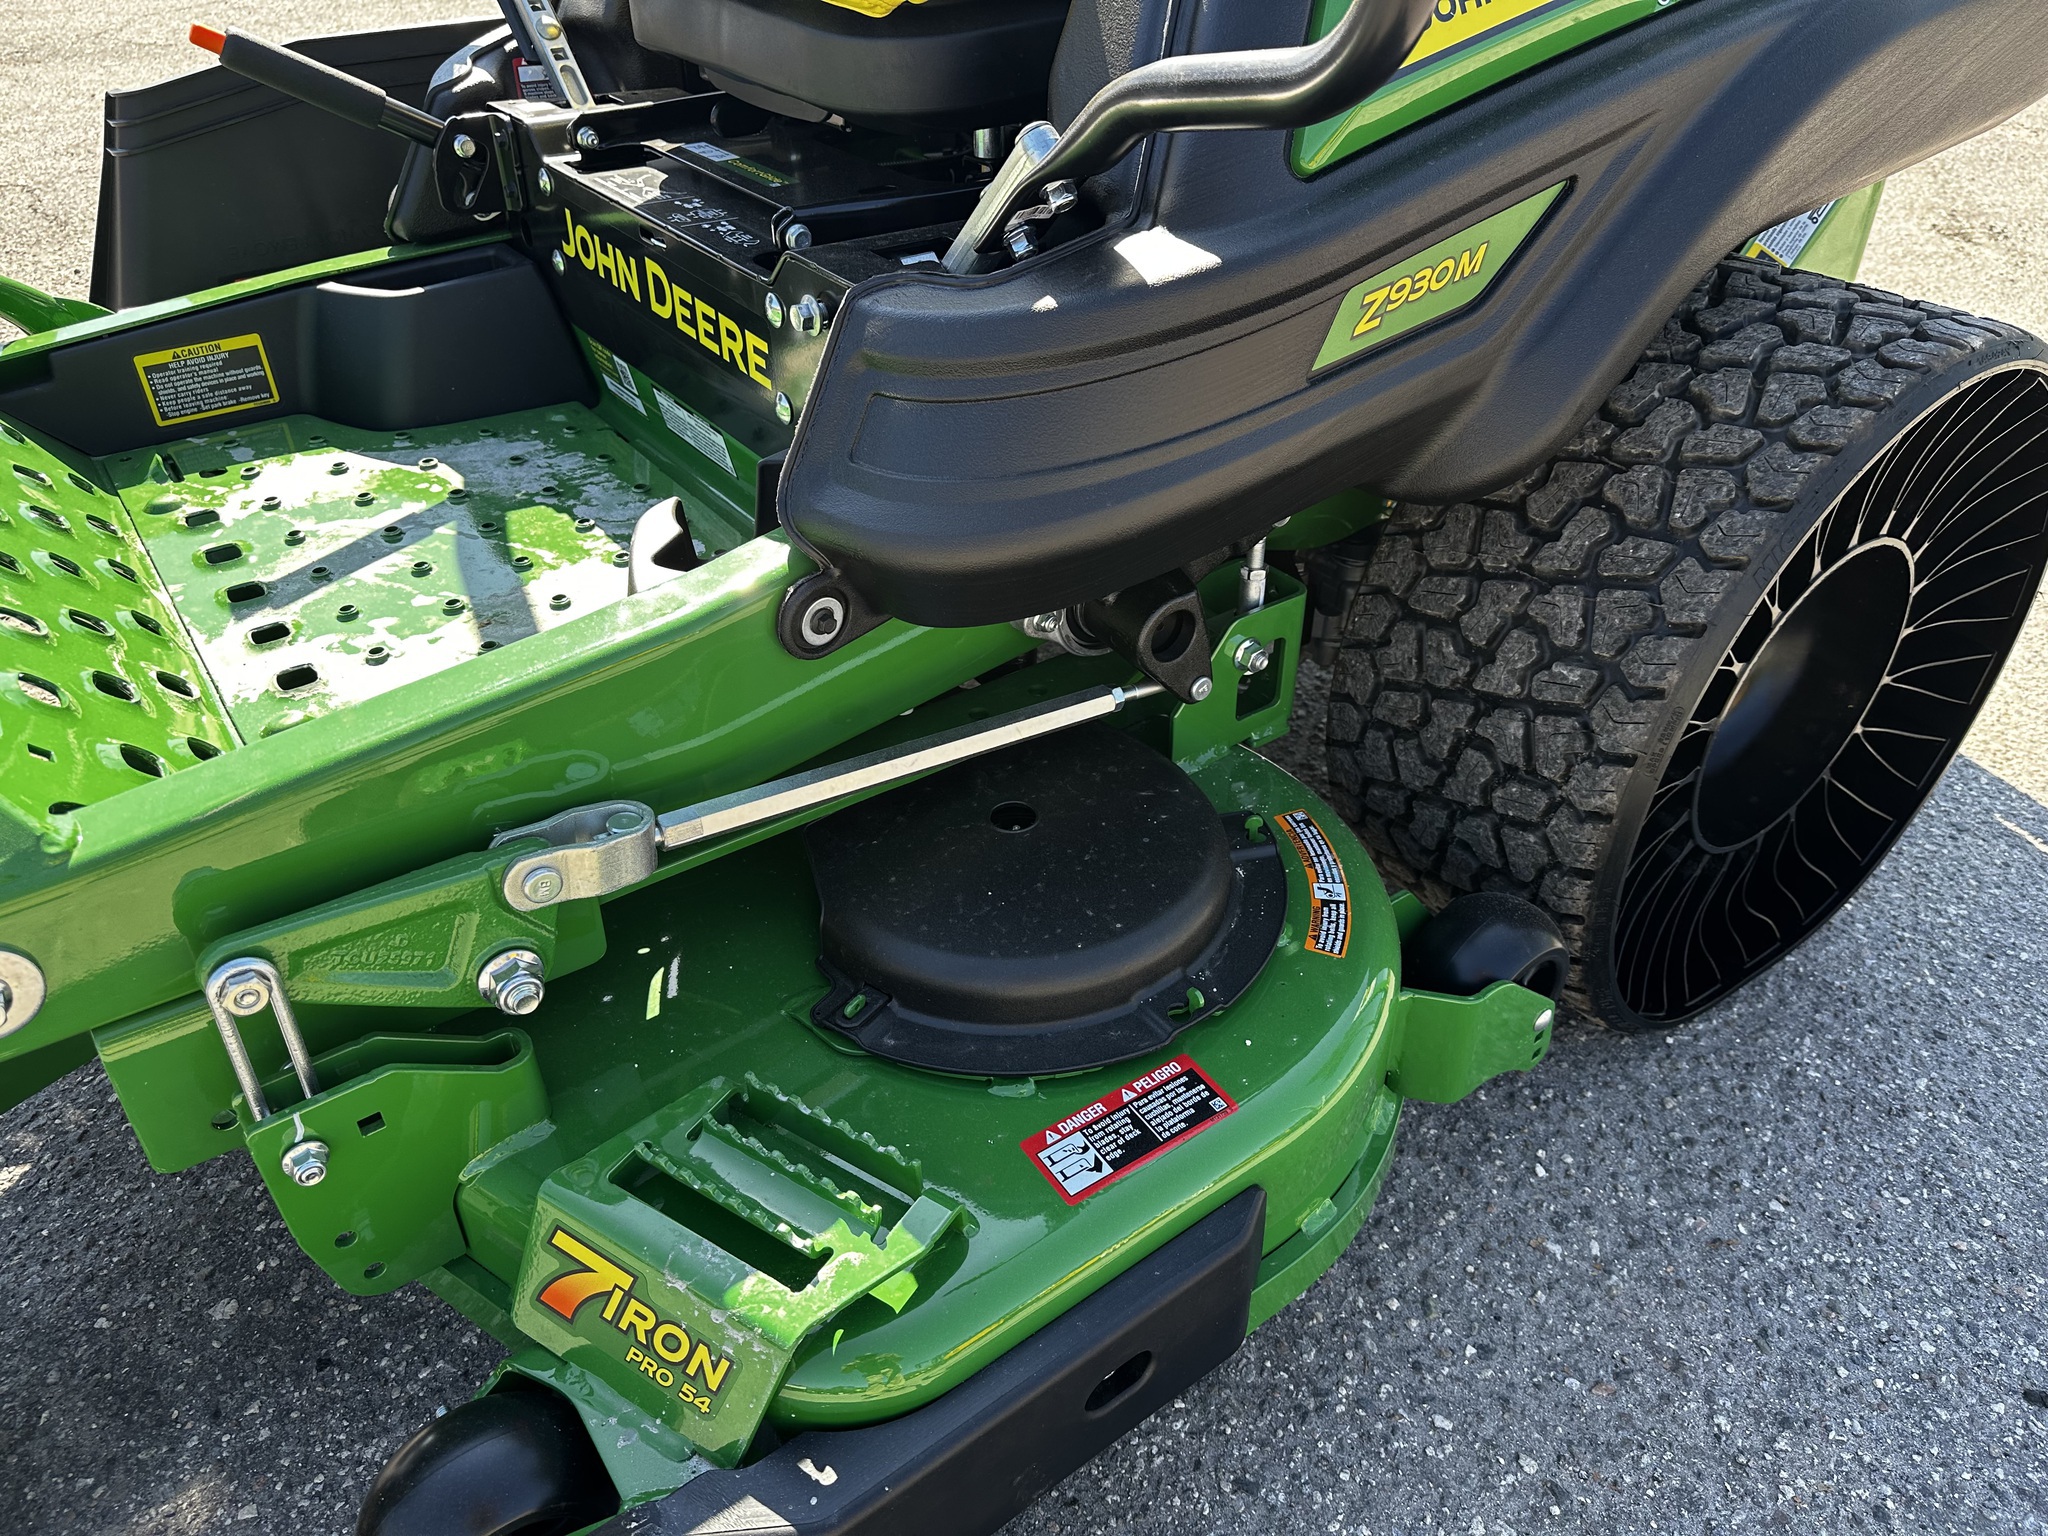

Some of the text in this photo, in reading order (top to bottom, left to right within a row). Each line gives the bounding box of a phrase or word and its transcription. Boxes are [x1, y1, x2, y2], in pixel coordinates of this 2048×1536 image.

[561, 207, 773, 391] JOHN DEERE
[1350, 240, 1490, 341] Z930M
[168, 352, 229, 369] HELP AVOID INJURY
[180, 343, 221, 357] CAUTION
[151, 360, 223, 379] Operator training required
[169, 371, 197, 382] operator's
[198, 367, 218, 375] manual
[173, 378, 193, 387] operate
[202, 372, 224, 380] machine
[225, 368, 244, 376] without
[201, 379, 219, 387] devices
[246, 370, 264, 379] working
[159, 393, 176, 401] Never
[161, 399, 176, 407] Keep
[177, 395, 196, 404] people
[214, 387, 237, 396] distance
[238, 384, 252, 392] away
[164, 404, 181, 412] Before
[182, 399, 203, 409] leaving
[180, 406, 198, 416] engine
[222, 398, 237, 406] brake
[260, 391, 270, 399] key
[1286, 828, 1310, 864] ADVERTENCIA
[1310, 906, 1321, 932] WARNING
[1317, 930, 1326, 943] avoid
[1323, 934, 1335, 951] rotating
[1131, 1061, 1183, 1093] PELIGRO
[1132, 1074, 1189, 1108] Para evitar lesiones
[1137, 1084, 1186, 1114] causadas por las
[1142, 1082, 1206, 1121] cuchillas, mantenerse
[1056, 1101, 1108, 1135] DANGER
[1082, 1127, 1095, 1136] To
[1109, 1106, 1132, 1122] injury
[1148, 1089, 1210, 1127] alejado del borde de
[1154, 1124, 1164, 1132] la
[1161, 1106, 1196, 1129] plataforma
[1087, 1115, 1132, 1142] from rotating
[1093, 1123, 1135, 1149] blades, stay
[1098, 1128, 1142, 1155] clear of deck
[1159, 1119, 1188, 1138] de corte.
[1104, 1146, 1126, 1161] edge.
[625, 1346, 713, 1415] PRO 54
